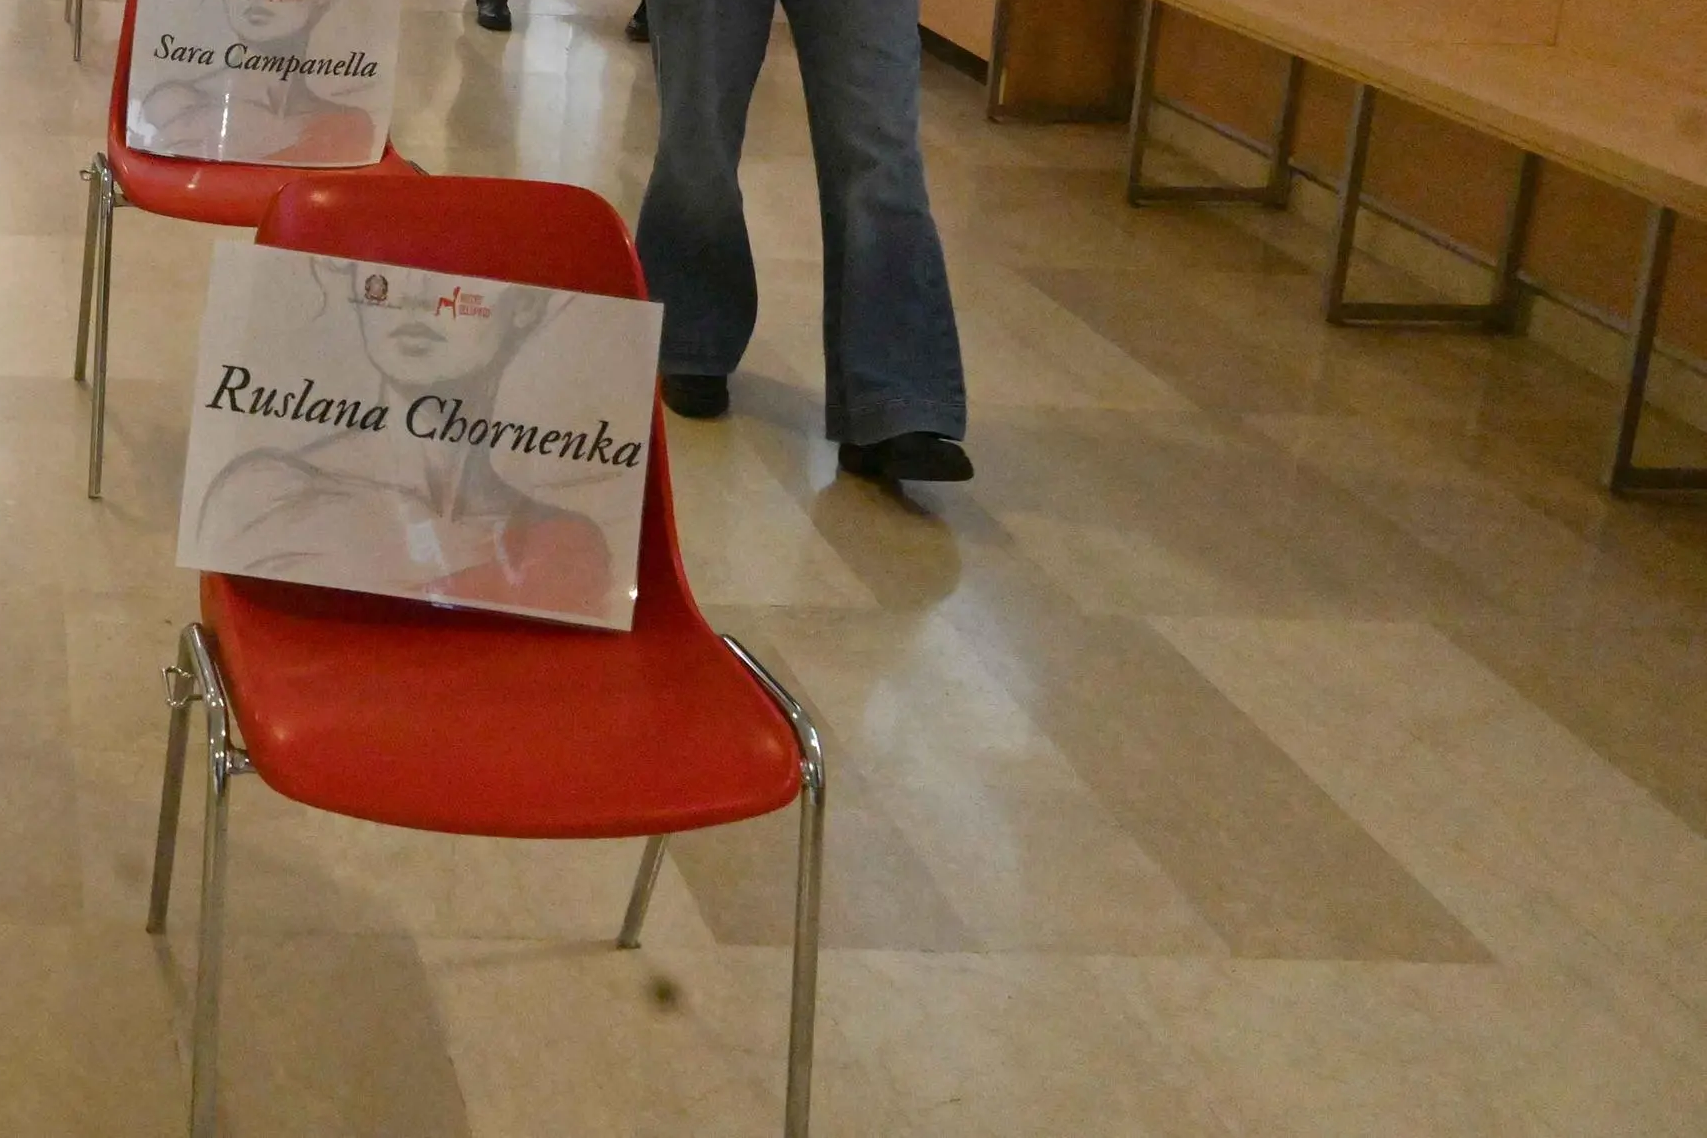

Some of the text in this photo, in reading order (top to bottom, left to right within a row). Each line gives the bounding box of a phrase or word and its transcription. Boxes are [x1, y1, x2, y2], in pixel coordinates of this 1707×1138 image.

[153, 33, 379, 82] Sara Campanella
[204, 363, 645, 469] Ruslana Chornenka
